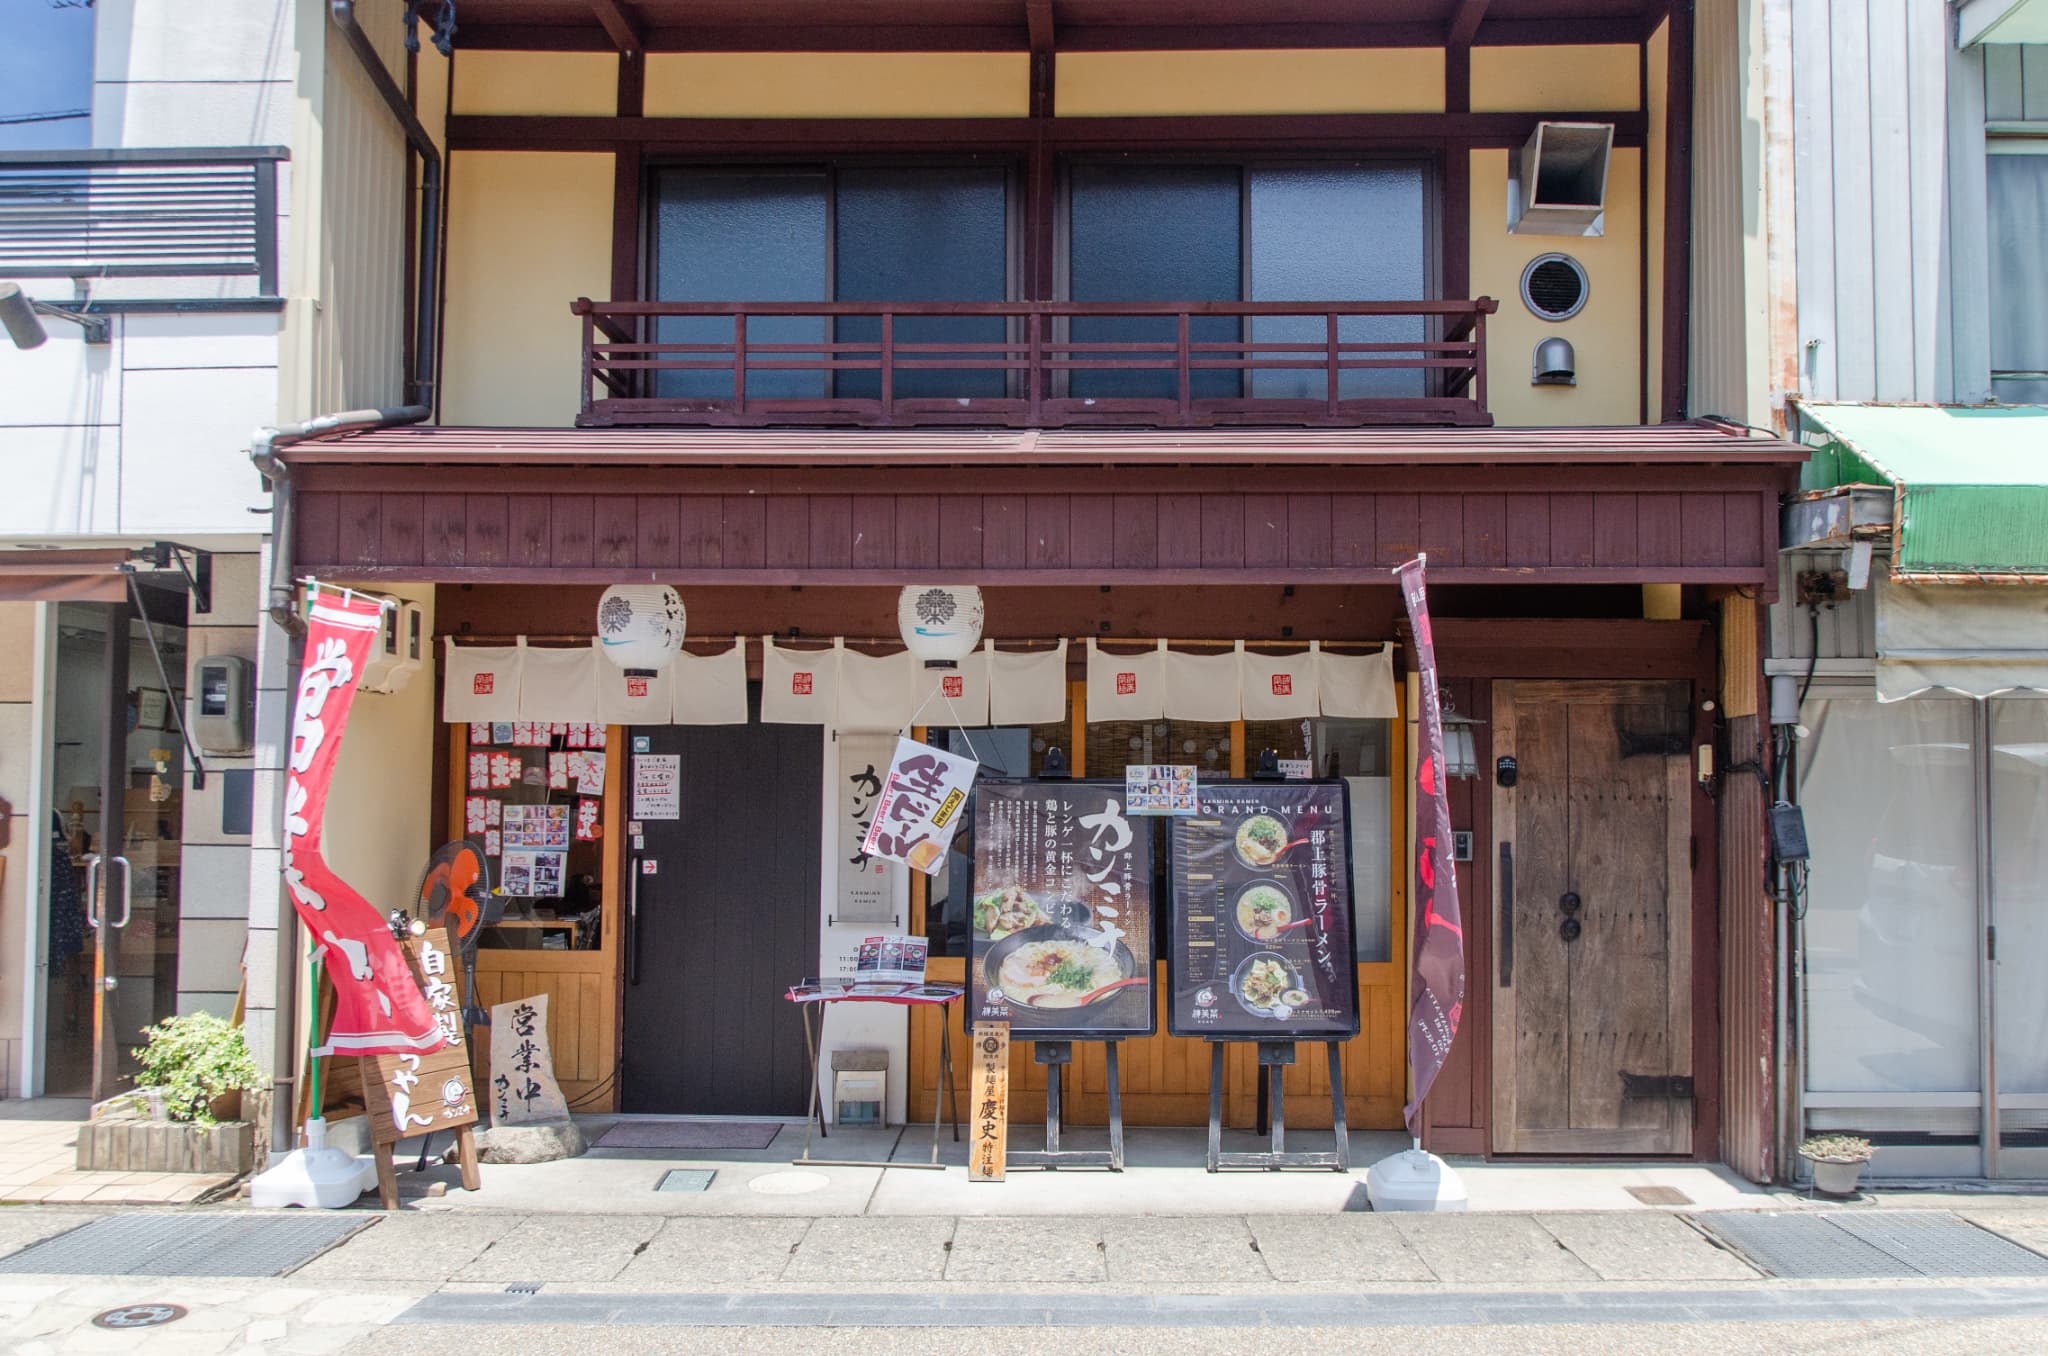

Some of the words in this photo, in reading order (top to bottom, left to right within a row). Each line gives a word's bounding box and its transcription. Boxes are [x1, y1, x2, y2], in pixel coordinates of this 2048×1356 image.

[1044, 799, 1058, 914] 鶏と豚の黄金コンビ
[1059, 800, 1074, 930] レンゲ一杯にこだわる
[1202, 805, 1269, 815] GRAND
[1281, 805, 1333, 815] MENU
[1078, 799, 1134, 959] カンミナ
[1309, 830, 1331, 964] 郡上豚骨ラーメン
[511, 1003, 541, 1113] 営業中
